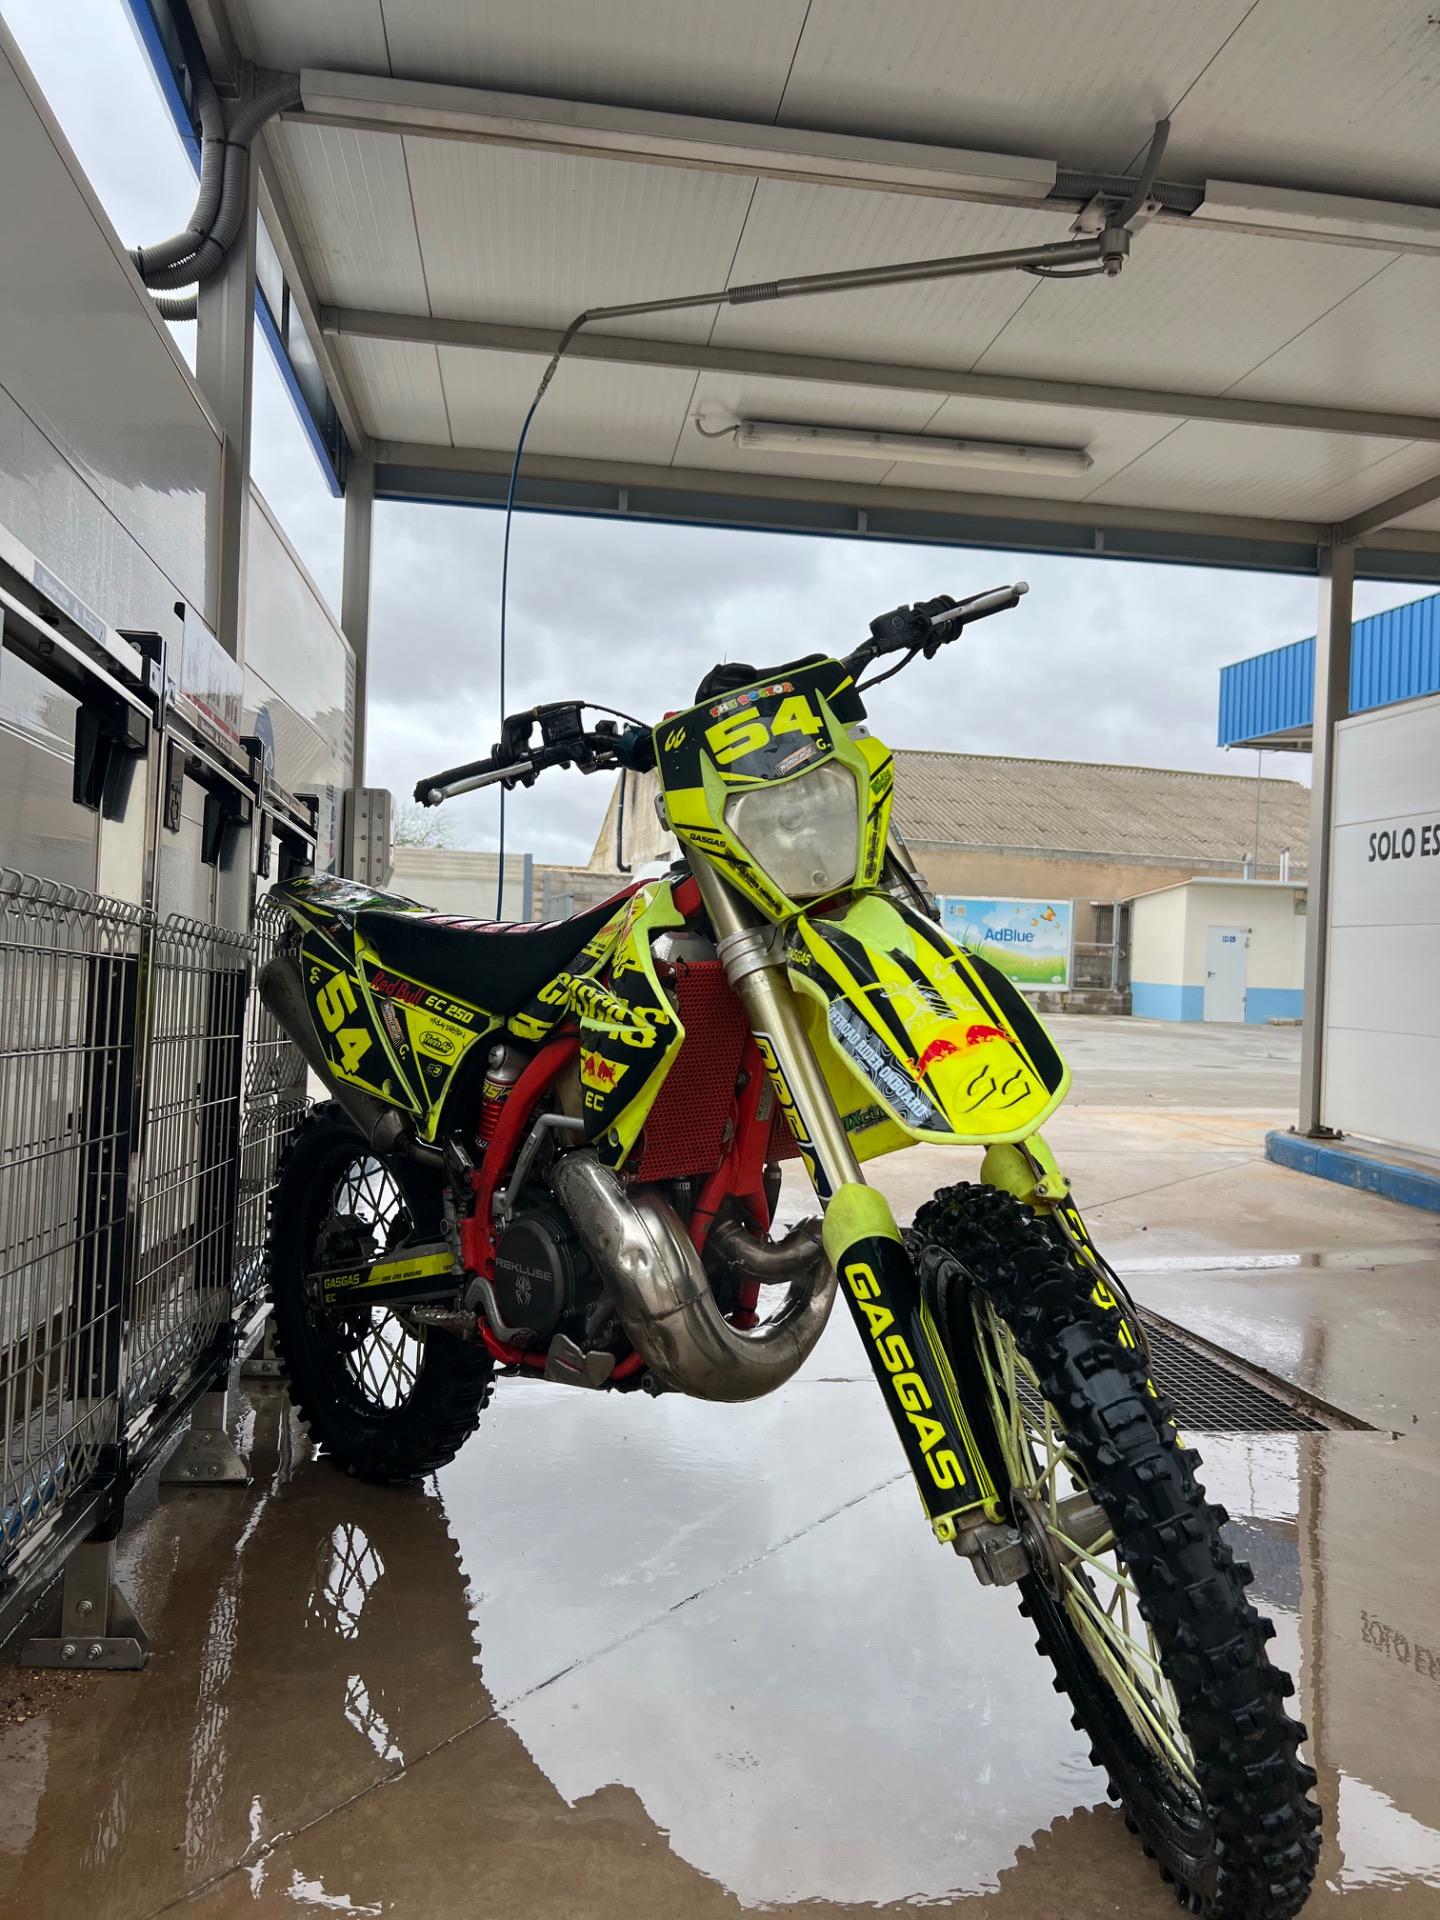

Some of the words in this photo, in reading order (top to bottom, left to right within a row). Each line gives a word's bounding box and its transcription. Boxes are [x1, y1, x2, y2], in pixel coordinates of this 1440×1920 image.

[704, 695, 824, 765] 54
[689, 833, 727, 848] GASGAS
[1368, 827, 1416, 862] SOLO
[984, 928, 1034, 942] AdBlue
[371, 970, 401, 996] Red
[395, 980, 428, 1007] Bull
[316, 970, 373, 1075] 54
[424, 994, 448, 1011] EC
[445, 1004, 475, 1024] 250
[855, 1039, 885, 1071] RIDER
[879, 1065, 929, 1117] ONBOARD
[584, 1090, 605, 1112] EC
[323, 1273, 360, 1289] GASGAS
[495, 1257, 553, 1284] REKLUSE
[325, 1292, 337, 1303] EC
[844, 1262, 966, 1490] GASGAS
